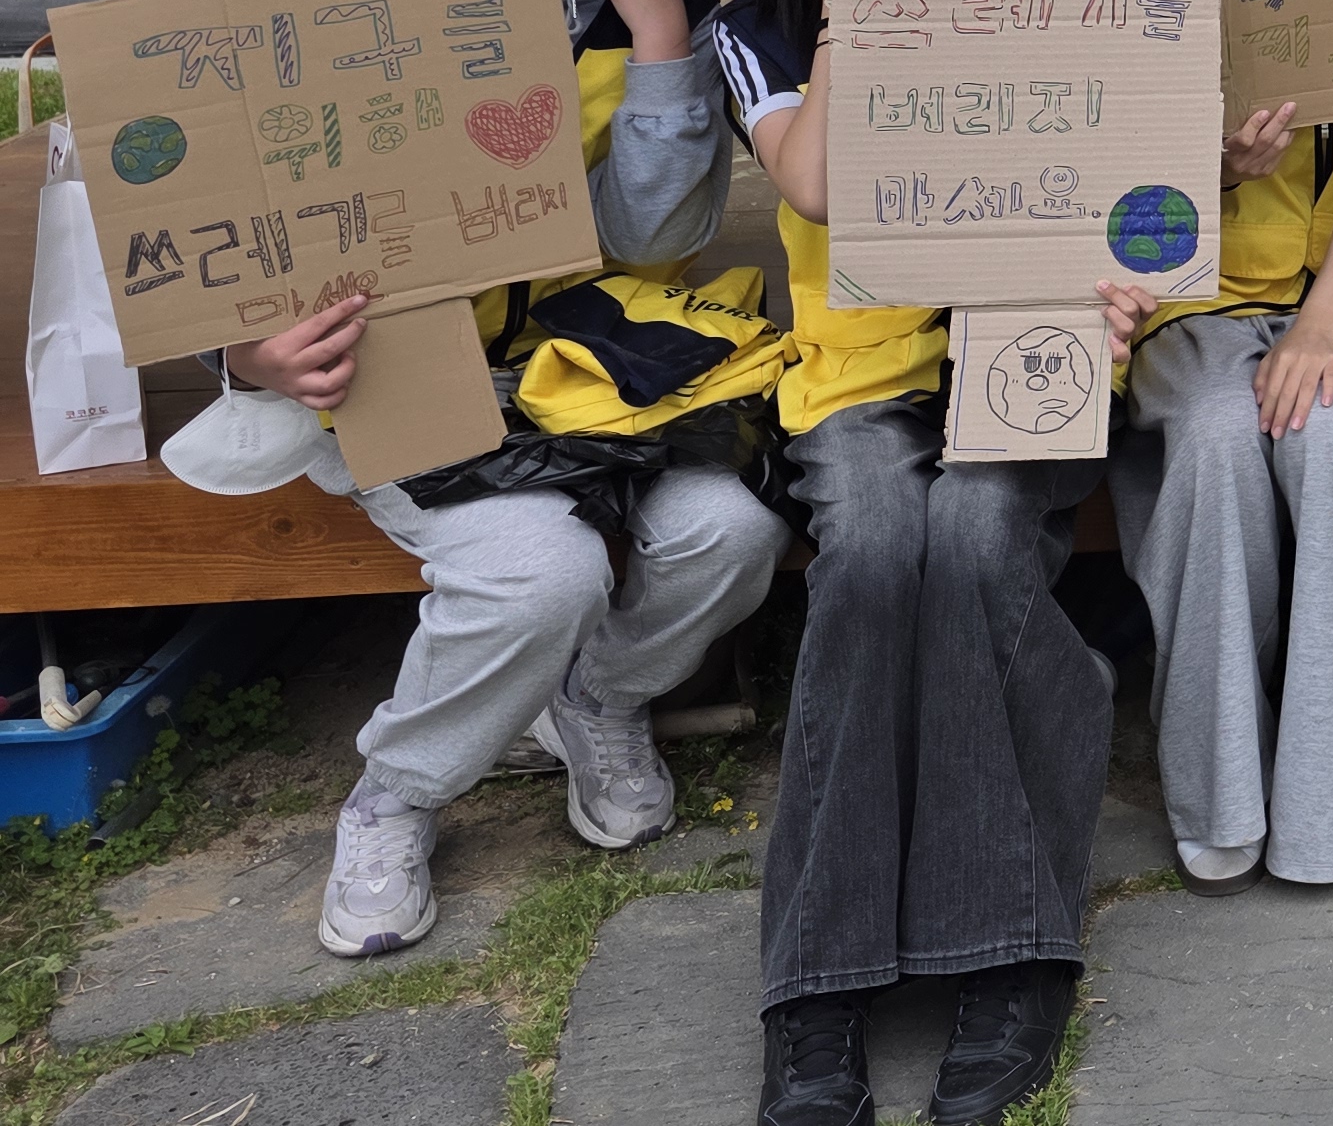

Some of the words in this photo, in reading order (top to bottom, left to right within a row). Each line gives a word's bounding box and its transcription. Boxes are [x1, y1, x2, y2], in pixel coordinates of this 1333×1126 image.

[258, 87, 444, 181] 위해
[868, 76, 1103, 136] 버리지
[125, 189, 414, 297] 쓰레기를
[450, 181, 568, 246] 버리지
[235, 270, 386, 326] 마세요
